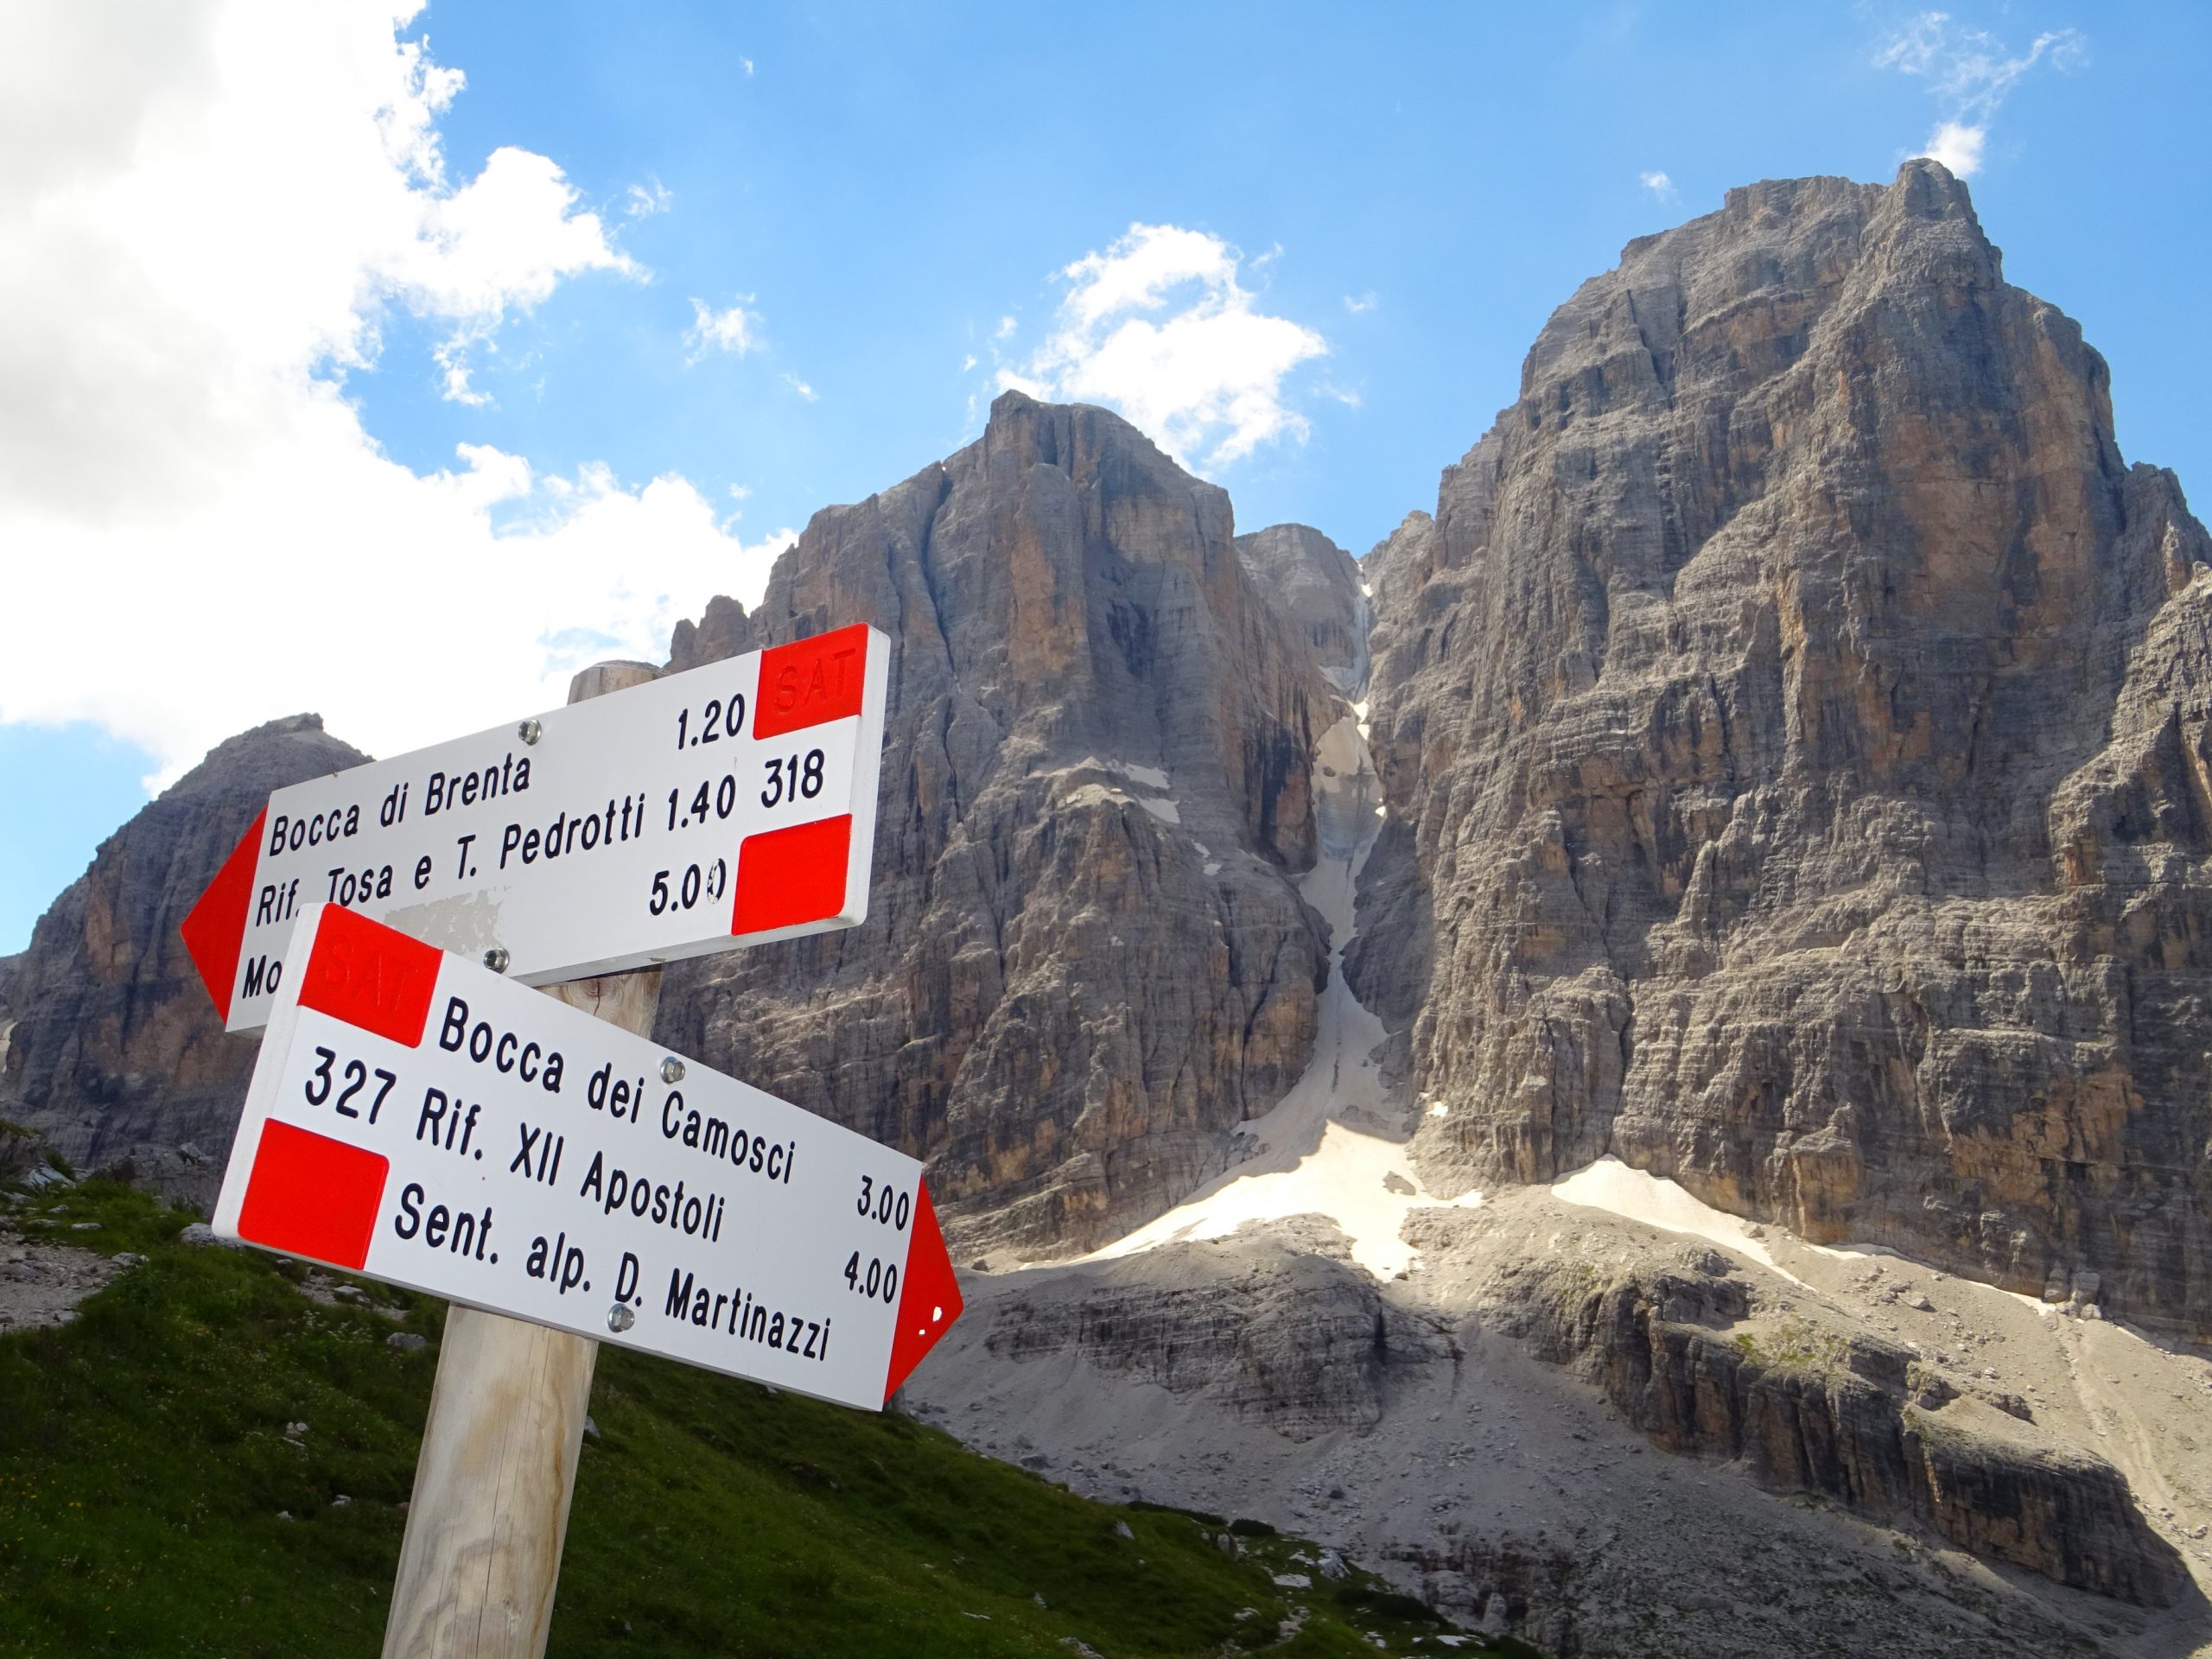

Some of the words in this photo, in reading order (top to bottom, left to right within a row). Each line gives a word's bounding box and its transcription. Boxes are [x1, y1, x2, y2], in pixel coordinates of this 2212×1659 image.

[773, 648, 856, 715] SAT
[269, 803, 360, 857] Bocca
[380, 782, 409, 828] di
[424, 752, 531, 817] Brenta
[677, 693, 746, 750] 1.20
[760, 748, 825, 809] 318
[327, 864, 393, 907] Tosa
[414, 855, 432, 890] e
[457, 834, 480, 887] T.
[499, 792, 645, 870] Pedrotti
[668, 774, 736, 831] 1.40
[649, 858, 727, 916] 5.00
[323, 935, 420, 1014] SAT
[305, 1046, 397, 1126] 327
[439, 996, 566, 1095] Bocca
[588, 1062, 645, 1124] dei
[661, 1090, 796, 1185] Camosci
[857, 1174, 910, 1232] 3.00
[416, 1087, 484, 1161] Rif.
[510, 1122, 564, 1186] XII
[580, 1150, 725, 1244] Apostoli
[843, 1250, 898, 1305] 4.00
[394, 1183, 499, 1265] Sent.
[525, 1231, 592, 1294] alp.
[614, 1251, 643, 1308] D.
[664, 1268, 832, 1363] Martinazzi
